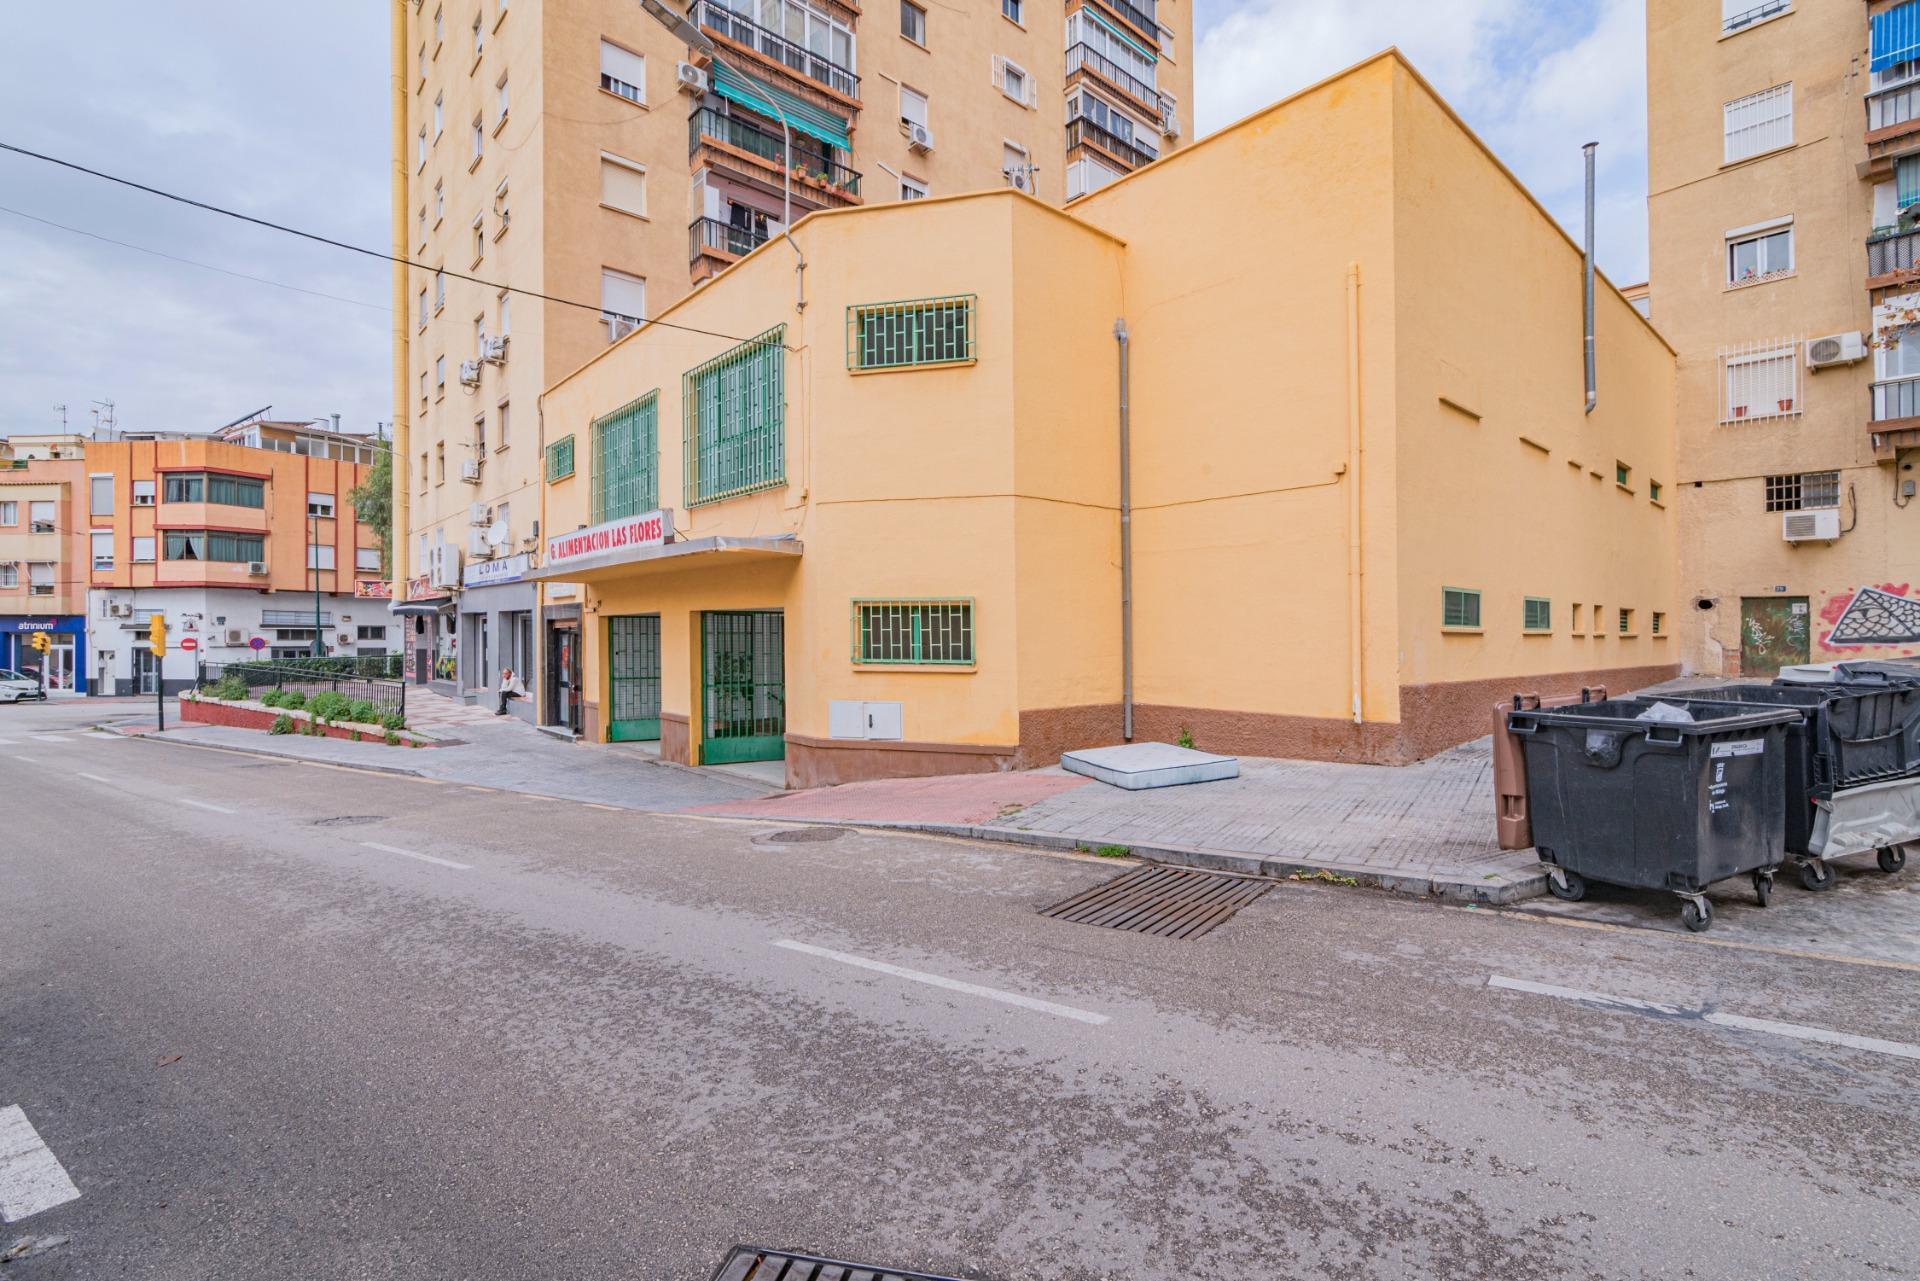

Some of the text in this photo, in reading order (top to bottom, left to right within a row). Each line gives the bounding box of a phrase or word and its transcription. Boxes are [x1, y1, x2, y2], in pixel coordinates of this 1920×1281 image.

[550, 517, 662, 560] G. ALIMENTACION LAS FLORES
[478, 560, 508, 575] LOMA
